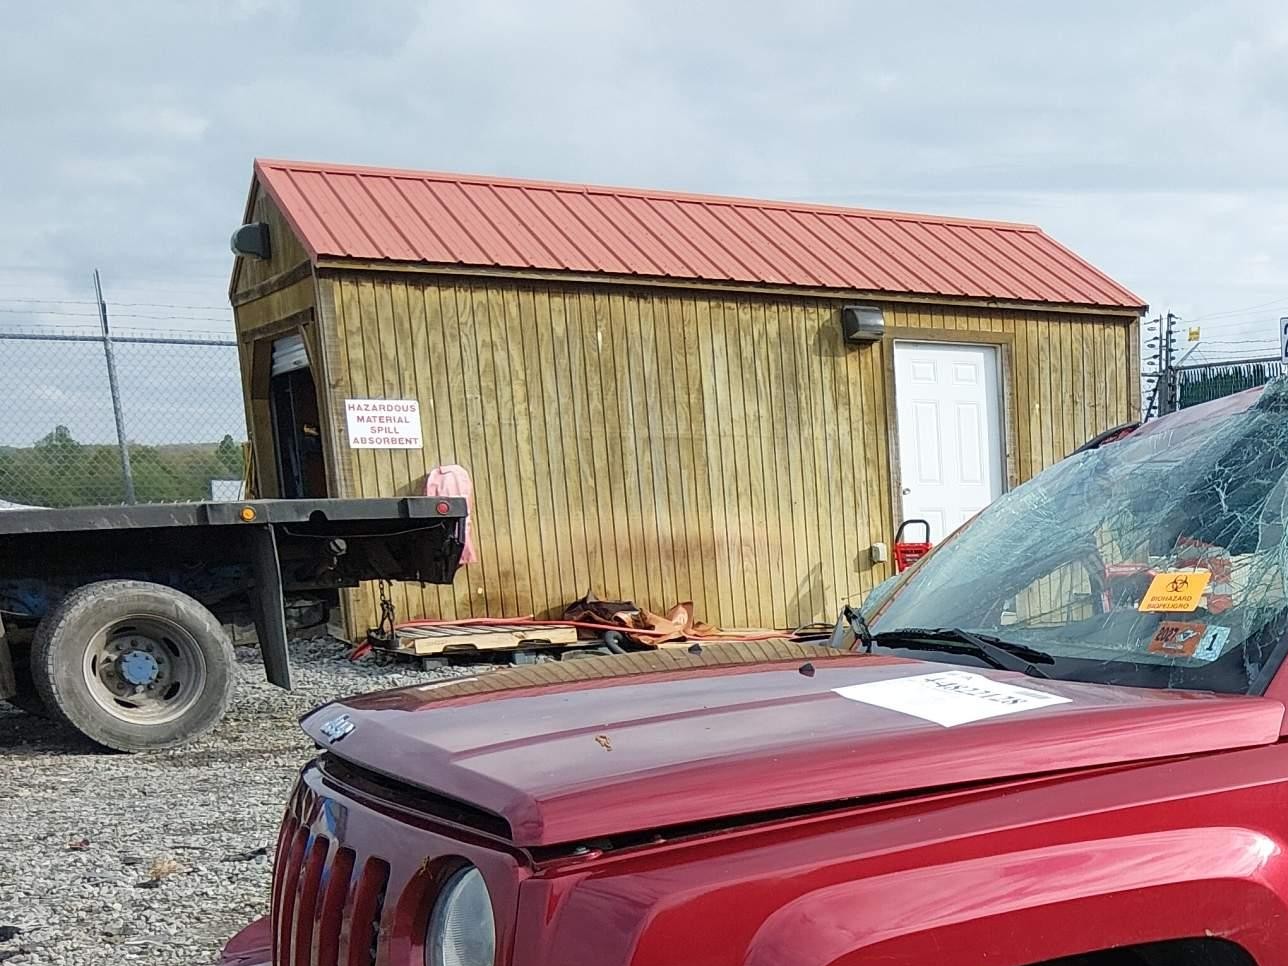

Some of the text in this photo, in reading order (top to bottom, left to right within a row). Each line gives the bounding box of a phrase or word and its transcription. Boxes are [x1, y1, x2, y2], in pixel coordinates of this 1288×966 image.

[347, 403, 416, 412] HAZARDOUS
[356, 415, 410, 424] MATERIAL
[369, 426, 400, 434] SPILL
[352, 437, 419, 445] ABSORBENT
[1206, 633, 1219, 651] 1
